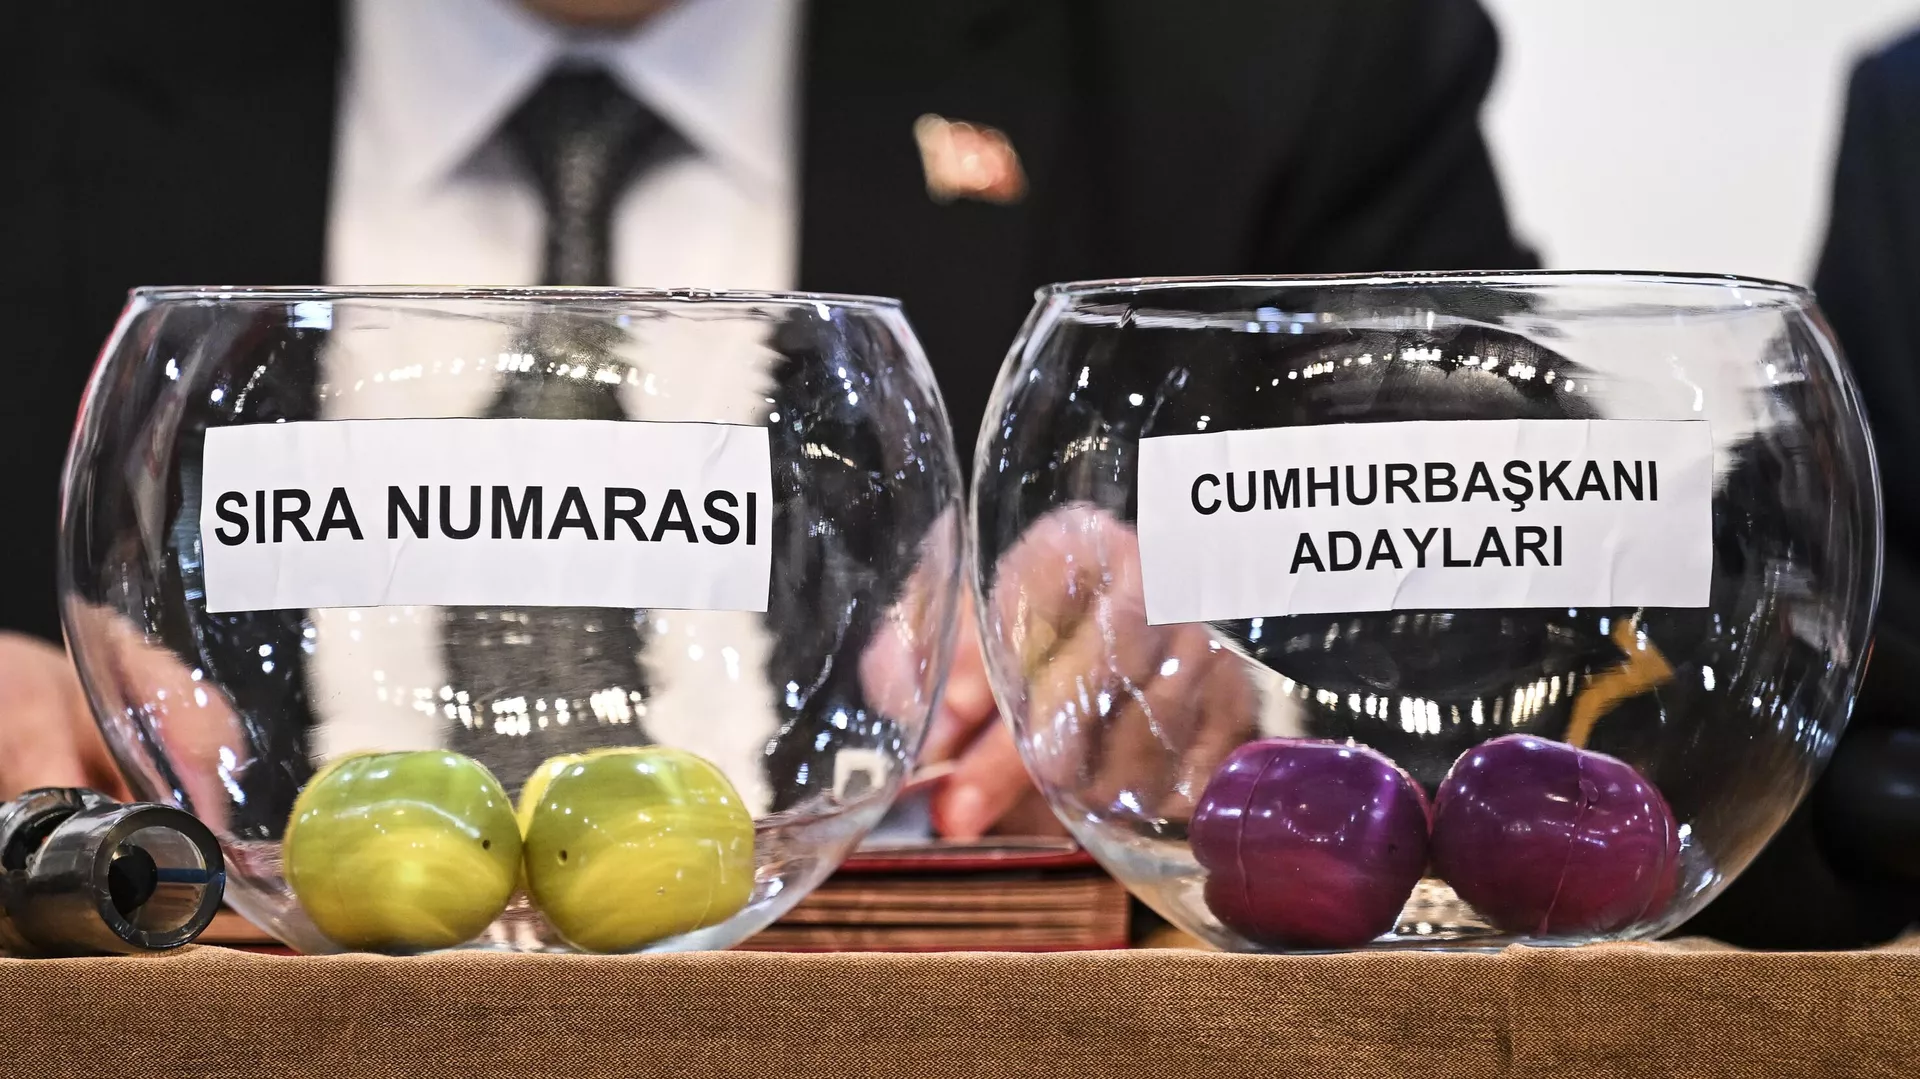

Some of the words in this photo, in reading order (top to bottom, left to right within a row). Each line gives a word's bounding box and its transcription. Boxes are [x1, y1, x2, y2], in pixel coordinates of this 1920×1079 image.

[214, 487, 364, 547] SIRA
[387, 485, 757, 545] NUMARASI
[1191, 460, 1658, 516] CUMHURBAŞKANI
[1289, 525, 1563, 574] ADAYLARI
